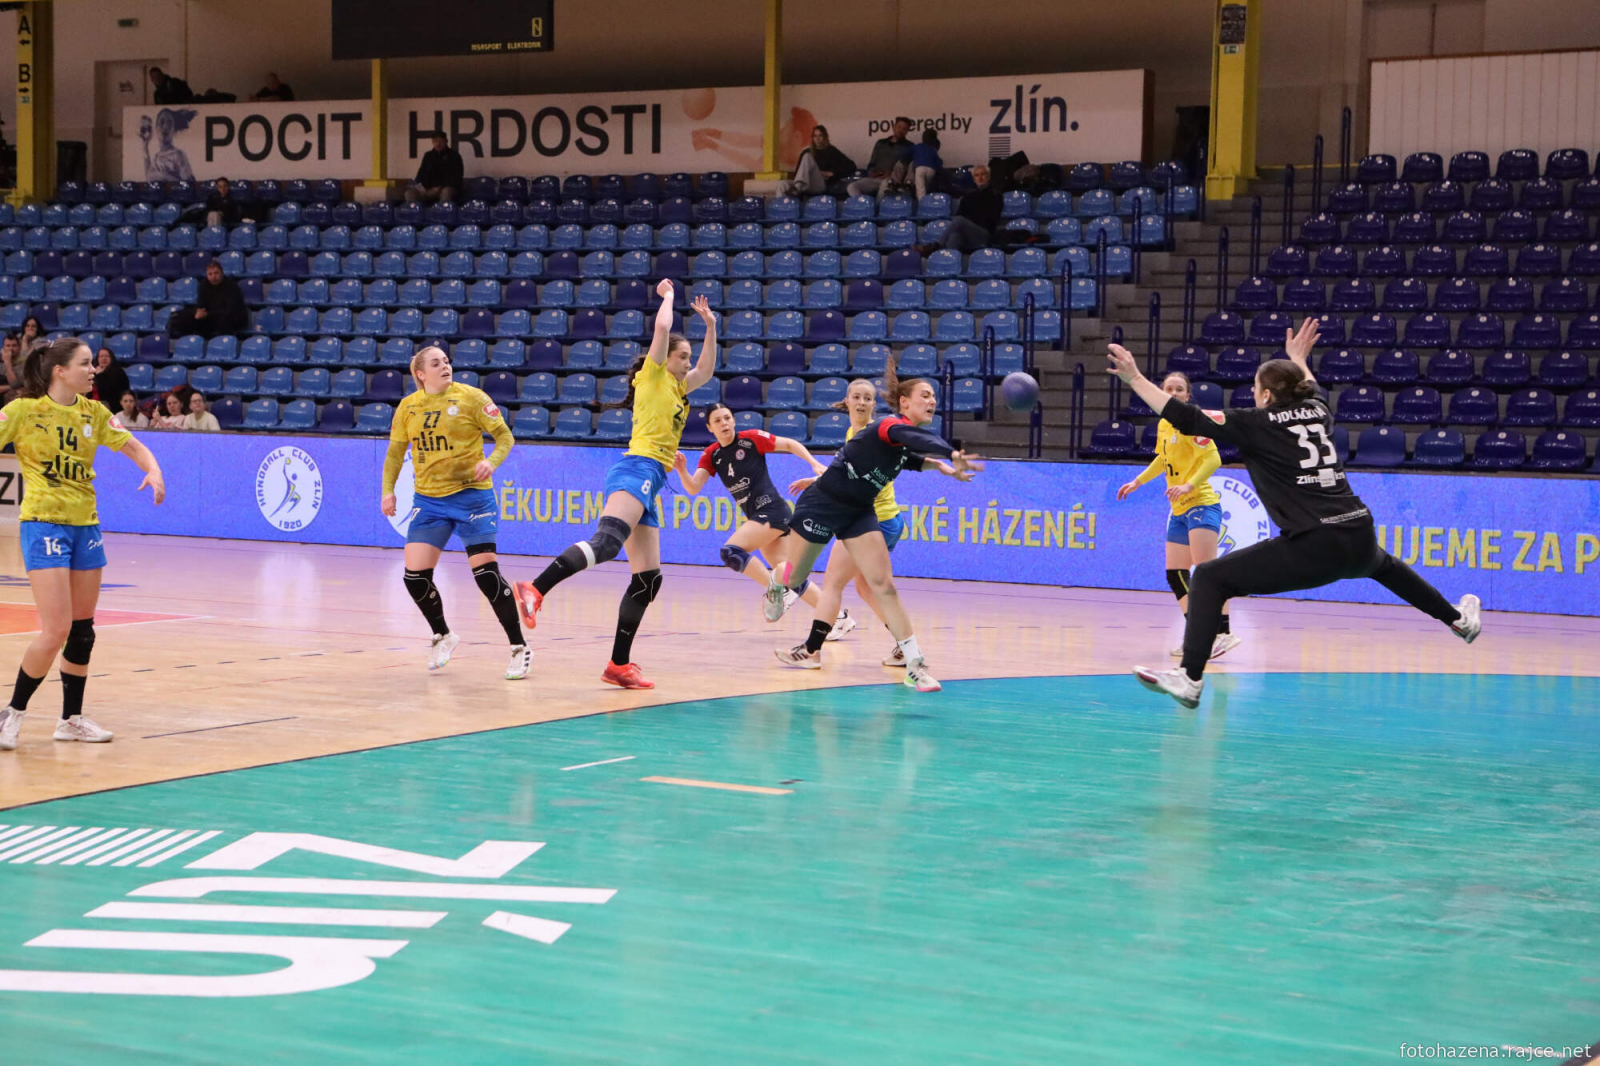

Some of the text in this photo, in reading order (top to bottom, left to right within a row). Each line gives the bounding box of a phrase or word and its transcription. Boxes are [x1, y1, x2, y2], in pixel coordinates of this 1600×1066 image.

[17, 15, 31, 35] A
[18, 63, 31, 83] B
[989, 84, 1079, 134] zlín.
[205, 104, 661, 162] POCIT HRDOSTI
[950, 112, 972, 134] by
[986, 337, 992, 350] 3
[945, 373, 951, 385] 2
[56, 426, 78, 451] 14
[1286, 423, 1338, 469] 33
[292, 449, 316, 472] CLUB
[727, 462, 735, 478] 4
[640, 479, 652, 496] 8
[1223, 479, 1260, 510] CLUB
[278, 519, 303, 530] 1920
[957, 498, 1097, 551] HÁZENÉ!
[43, 536, 63, 556] 14
[1512, 530, 1565, 574] ZA
